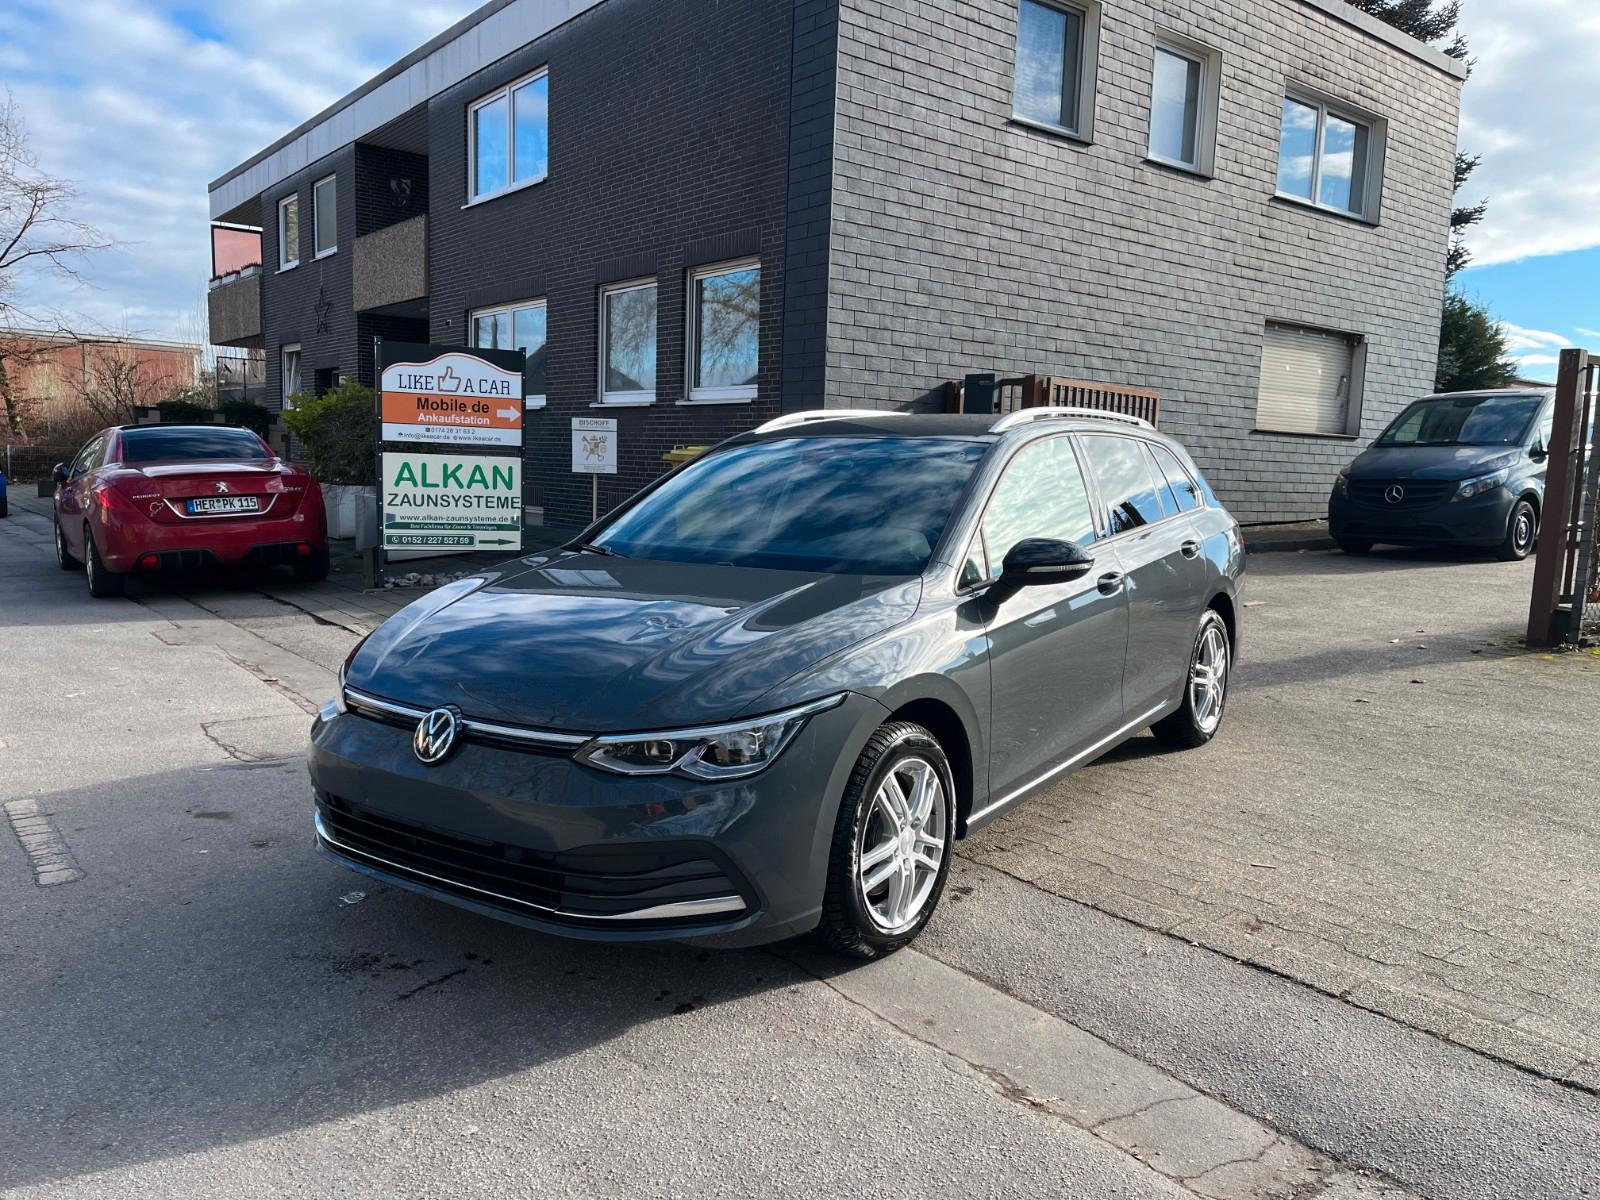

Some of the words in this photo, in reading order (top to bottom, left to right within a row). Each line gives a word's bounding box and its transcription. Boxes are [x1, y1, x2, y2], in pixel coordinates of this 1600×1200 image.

[398, 373, 434, 391] LIKE
[463, 378, 475, 393] A
[479, 379, 511, 395] CAR
[416, 397, 490, 414] Mobile.de
[417, 412, 490, 425] Ankaufstation
[394, 461, 513, 491] ALKAN
[195, 500, 216, 511] HER
[222, 498, 236, 509] PK
[238, 497, 257, 508] 115
[387, 493, 521, 510] ZAUNSYSTEME
[399, 514, 509, 524] www.alkan-zaunsysteme.de
[402, 536, 422, 544] 0152
[427, 536, 442, 544] 227
[443, 536, 459, 544] 527
